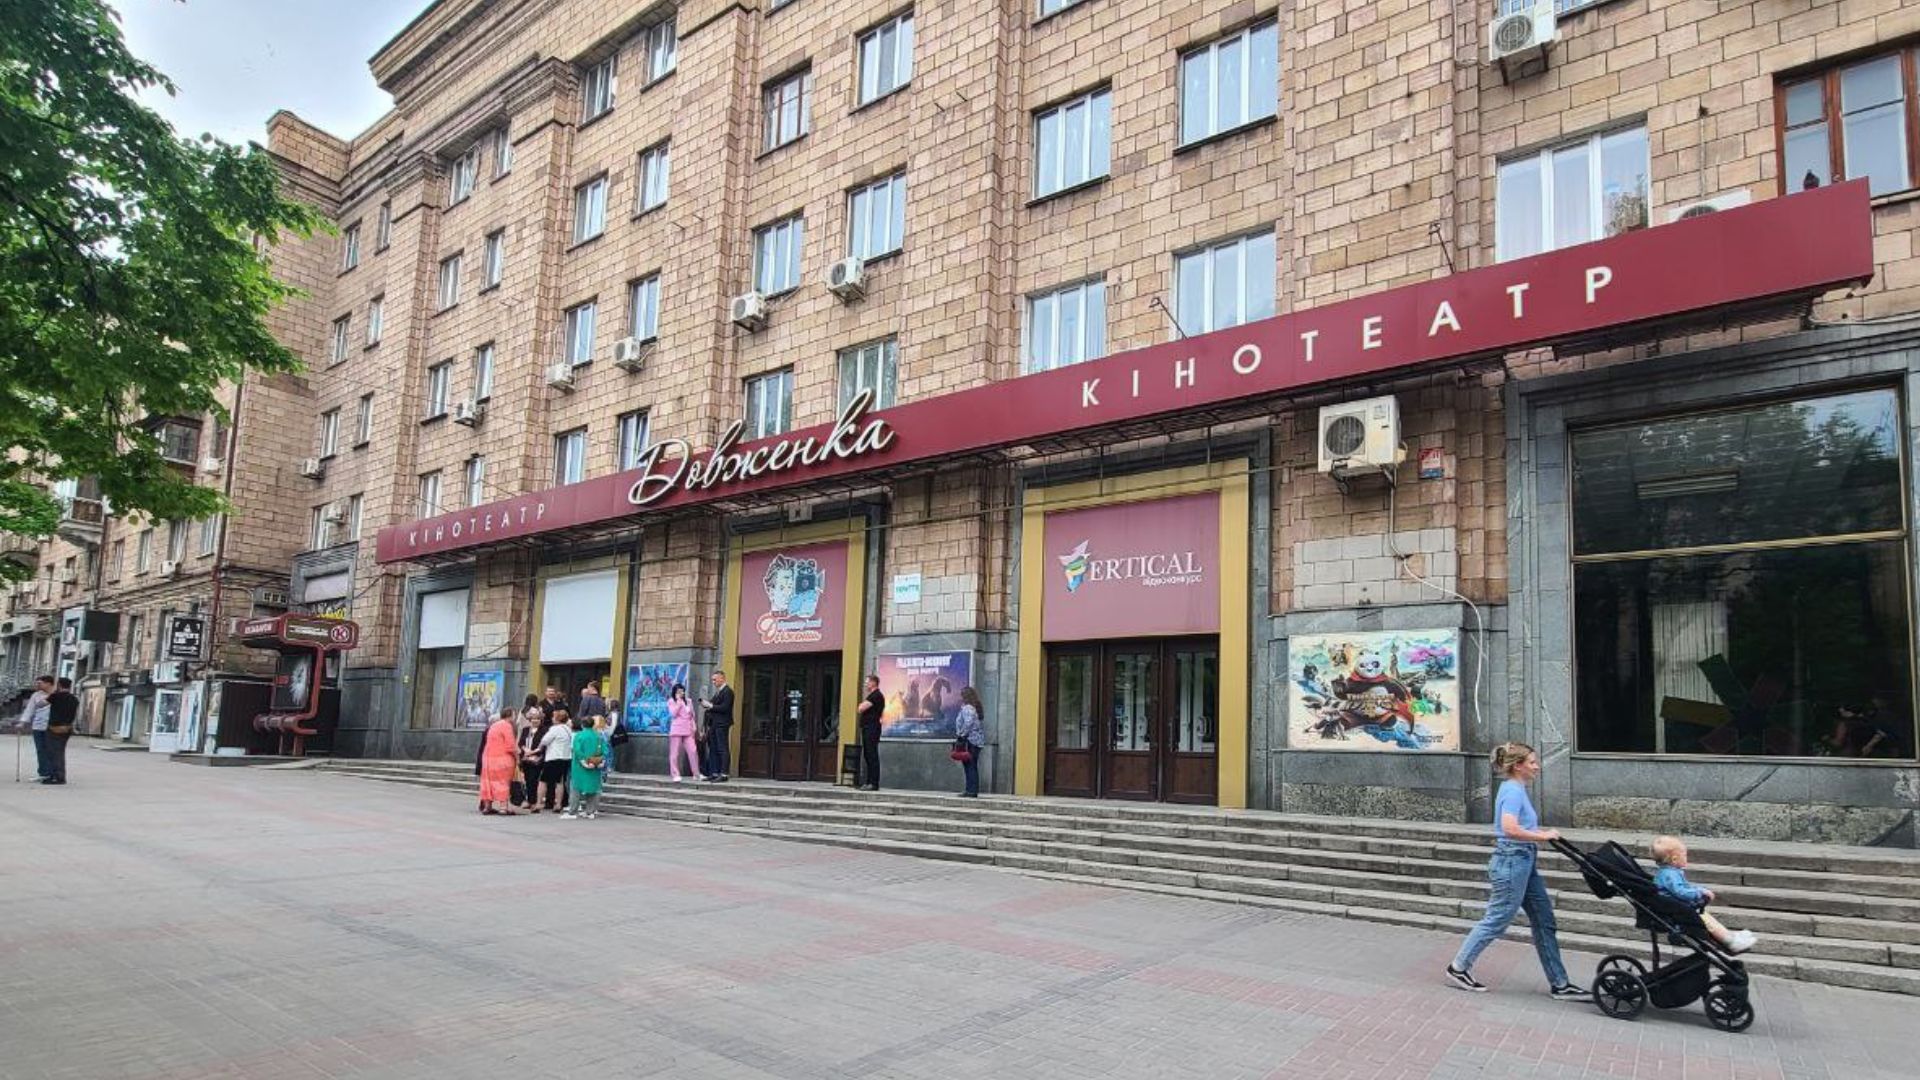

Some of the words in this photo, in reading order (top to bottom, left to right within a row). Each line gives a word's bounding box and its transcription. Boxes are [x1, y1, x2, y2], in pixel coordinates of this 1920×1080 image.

[1082, 266, 1613, 408] КІНОТЕАТР
[628, 387, 897, 505] Довженка
[408, 502, 547, 547] КІНОТЕАТР
